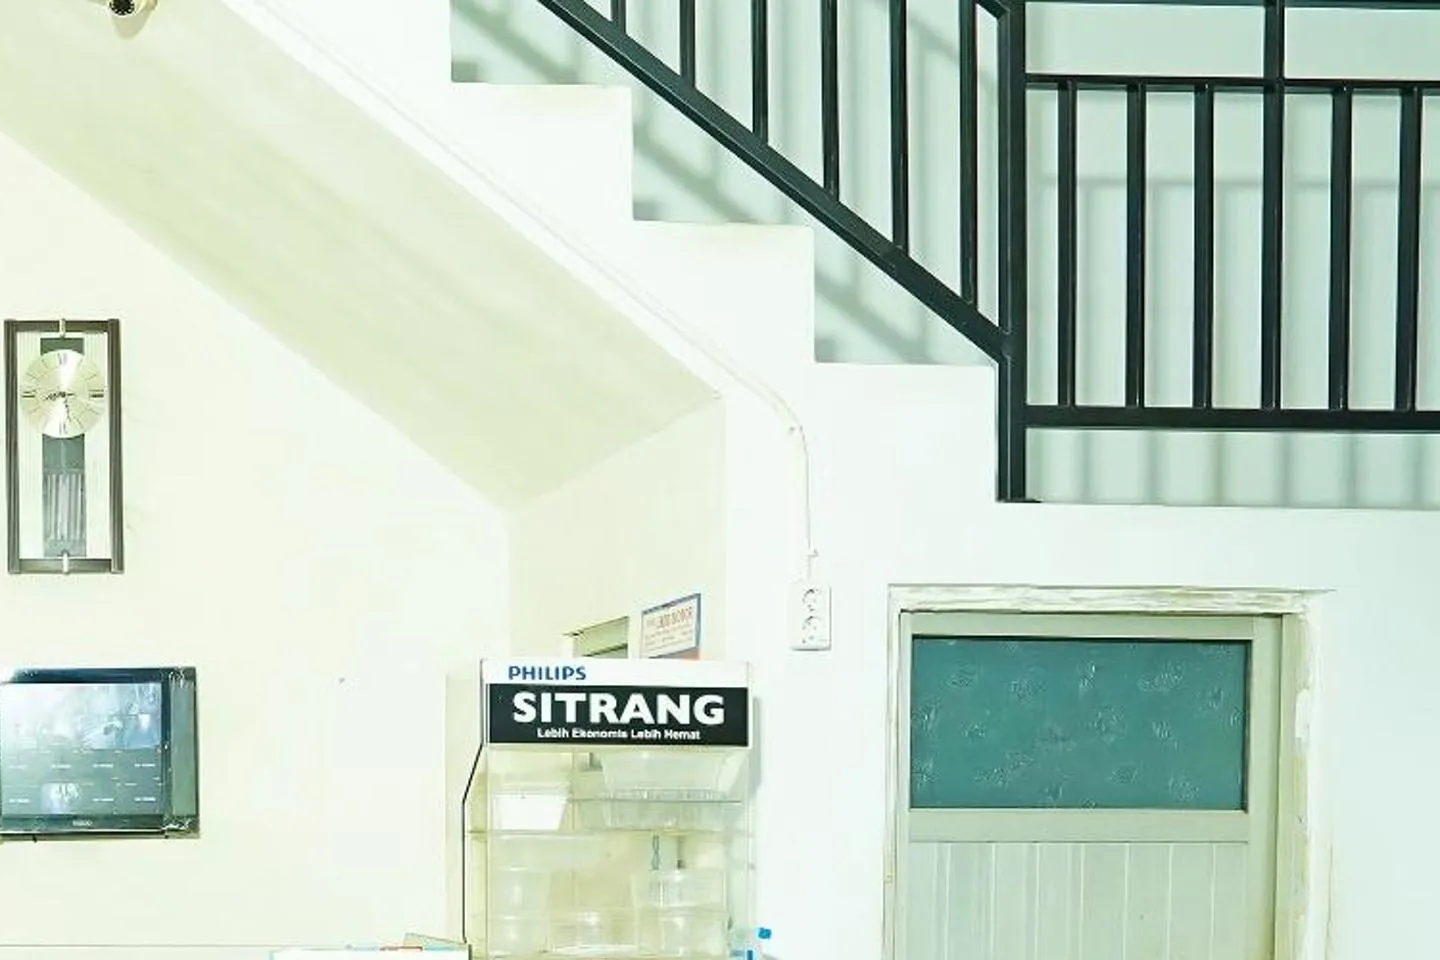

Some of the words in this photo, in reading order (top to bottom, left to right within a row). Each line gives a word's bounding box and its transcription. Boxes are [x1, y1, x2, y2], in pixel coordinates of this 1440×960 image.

[508, 666, 587, 681] PHILIPS
[512, 691, 725, 726] SITRANG
[537, 727, 569, 739] Lebih
[631, 728, 661, 739] Lebih
[664, 729, 701, 740] Hemat
